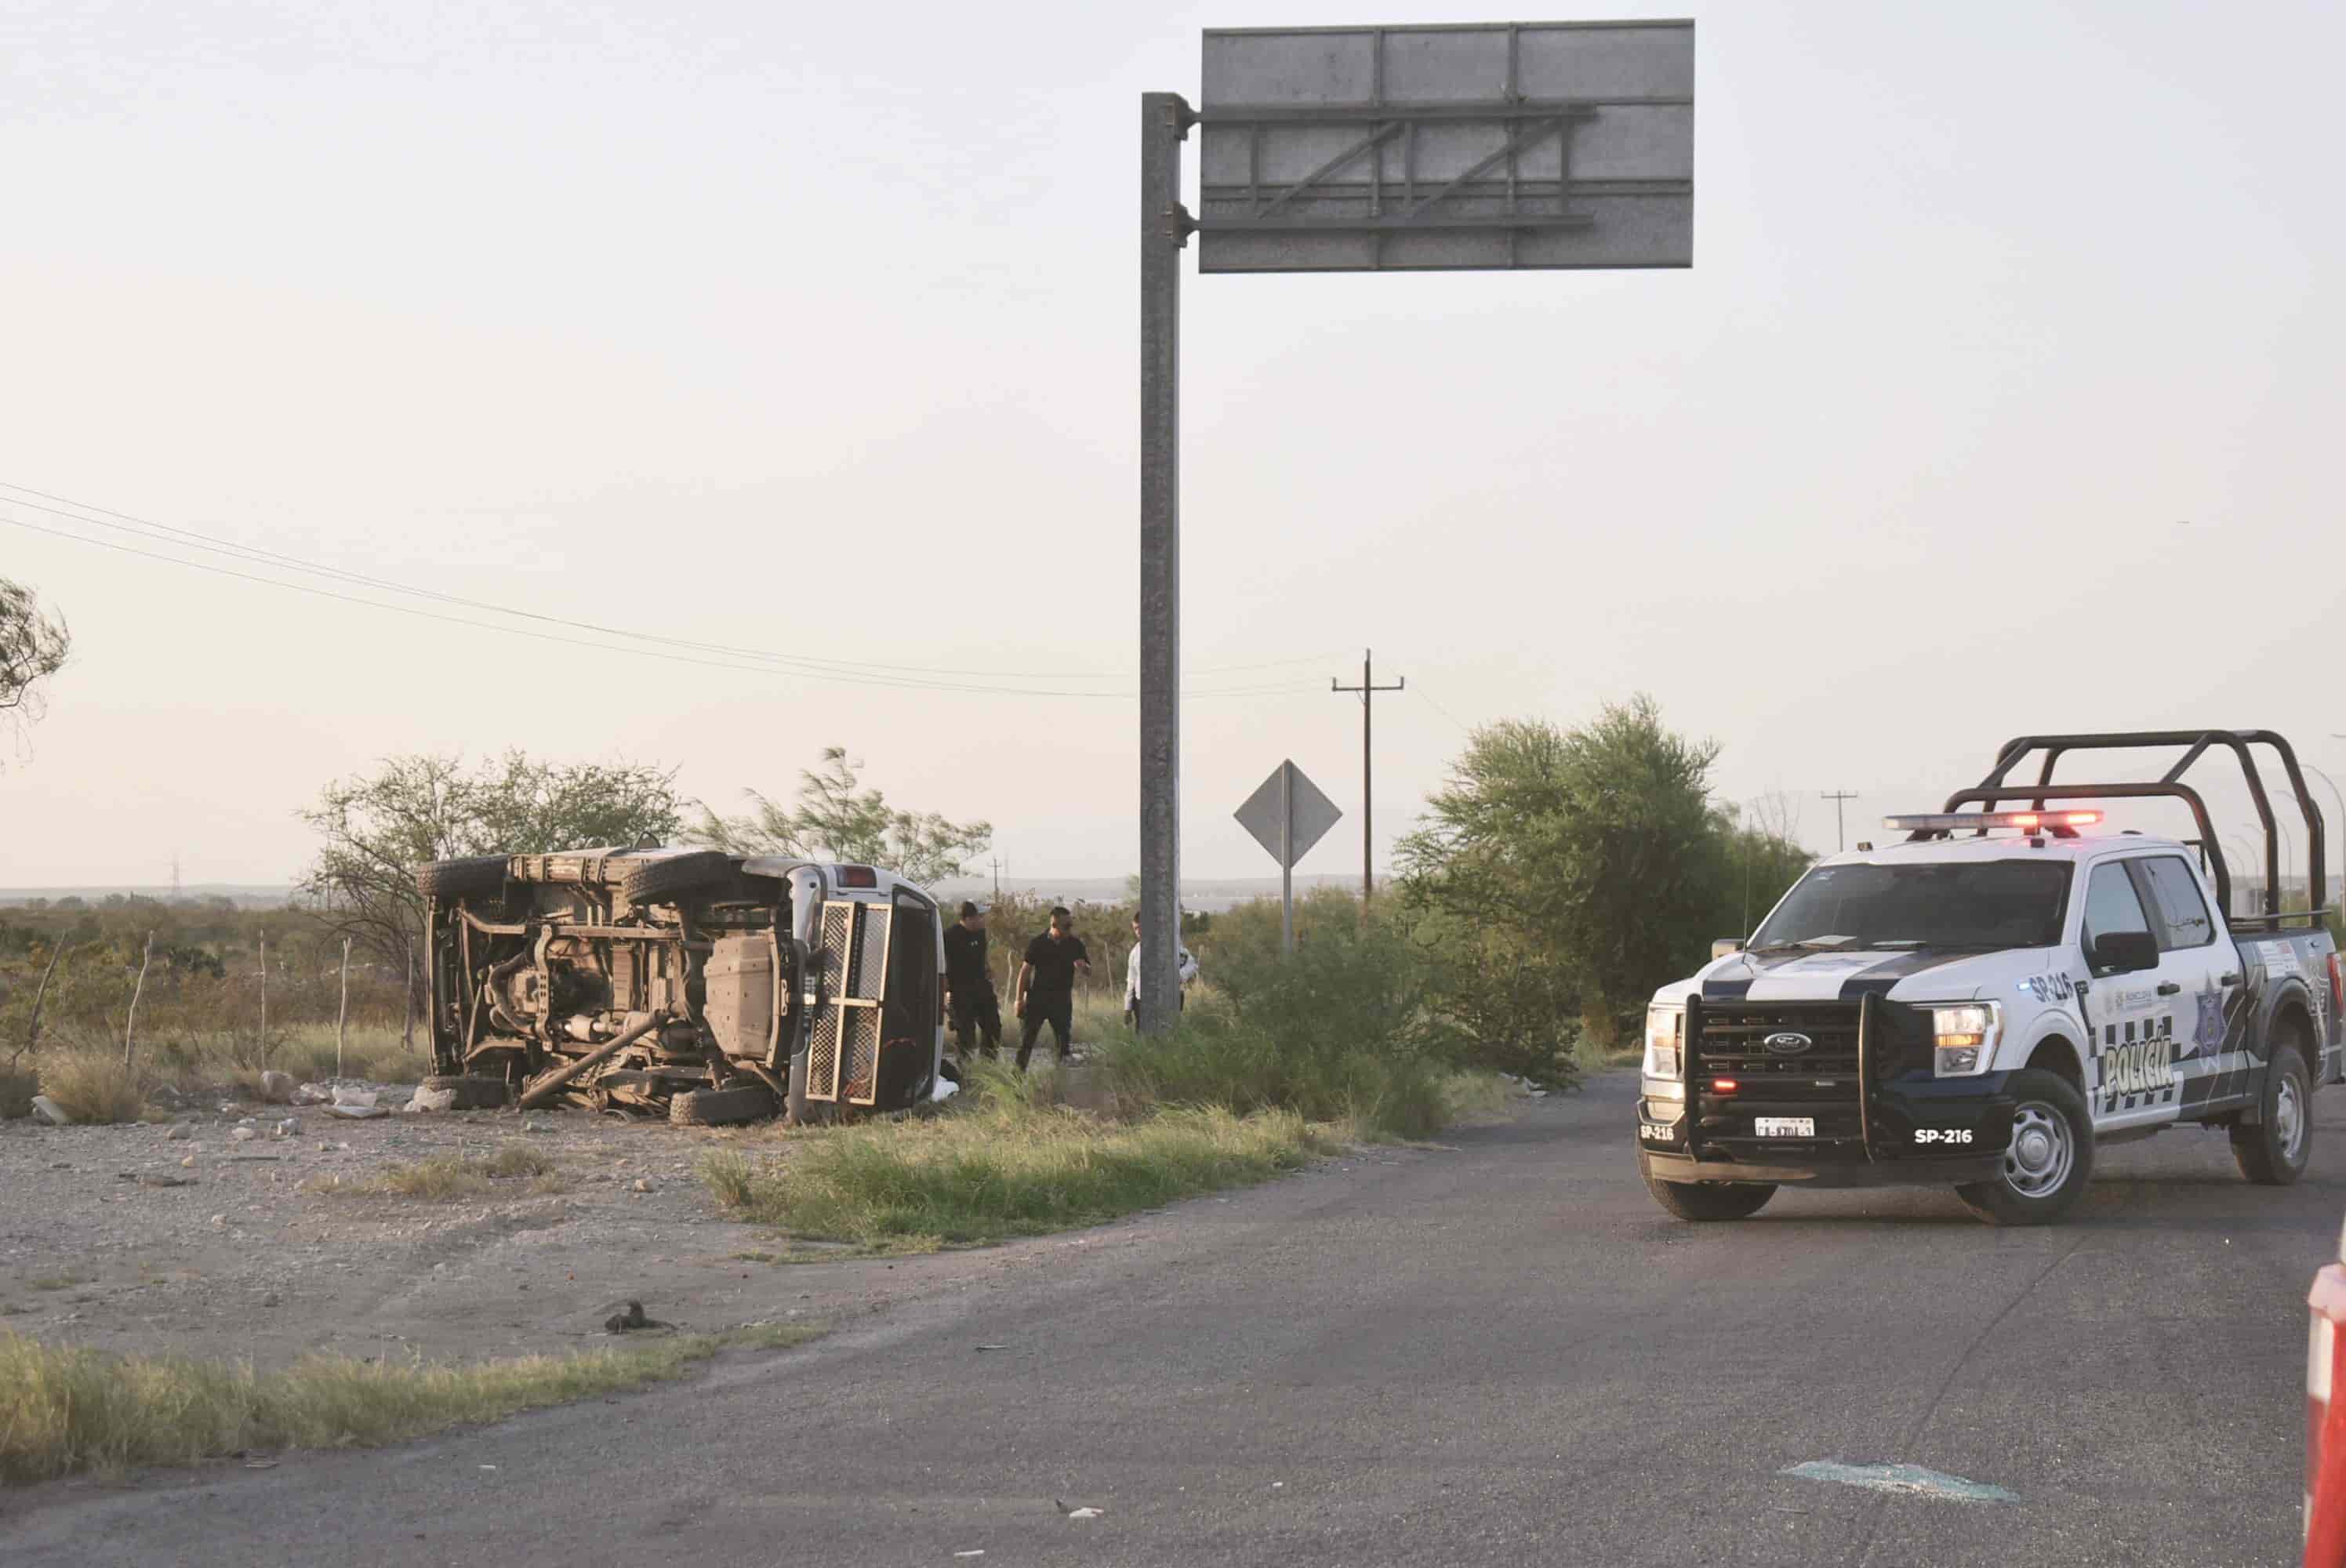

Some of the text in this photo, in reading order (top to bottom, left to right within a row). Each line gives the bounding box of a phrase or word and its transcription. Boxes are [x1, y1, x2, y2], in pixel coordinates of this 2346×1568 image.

[2030, 972, 2073, 1002] SP-216
[1641, 1126, 1674, 1141] SP-216
[1915, 1129, 1973, 1143] SP-216
